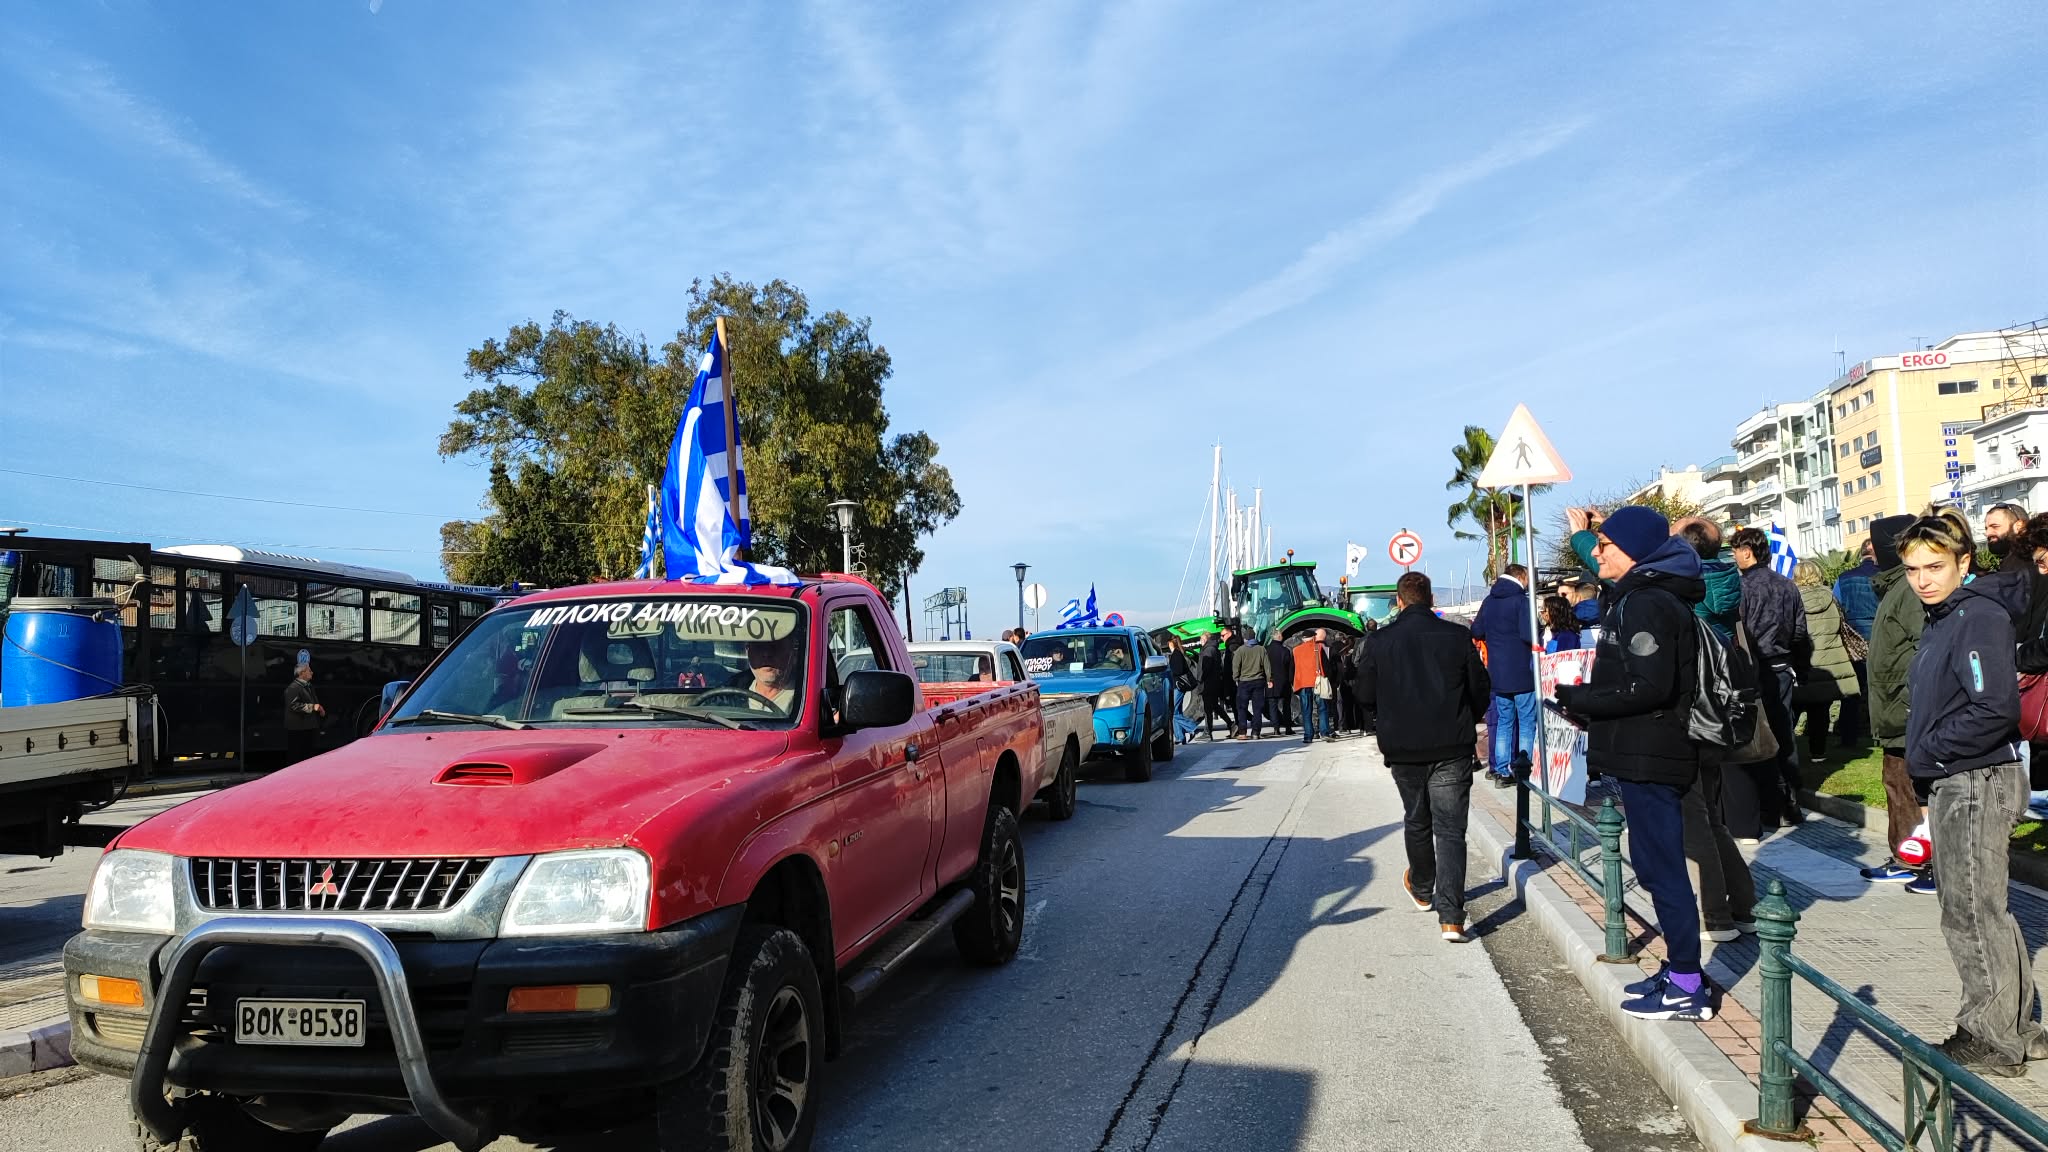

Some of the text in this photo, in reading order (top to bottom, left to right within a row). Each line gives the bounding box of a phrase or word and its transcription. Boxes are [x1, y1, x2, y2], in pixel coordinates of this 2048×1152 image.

[1902, 353, 1946, 367] ERGO
[1945, 428, 1959, 479] HOTEL
[524, 602, 758, 627] ΜΠΛΟΚΟ ΑΛΜΥΡΟΥ
